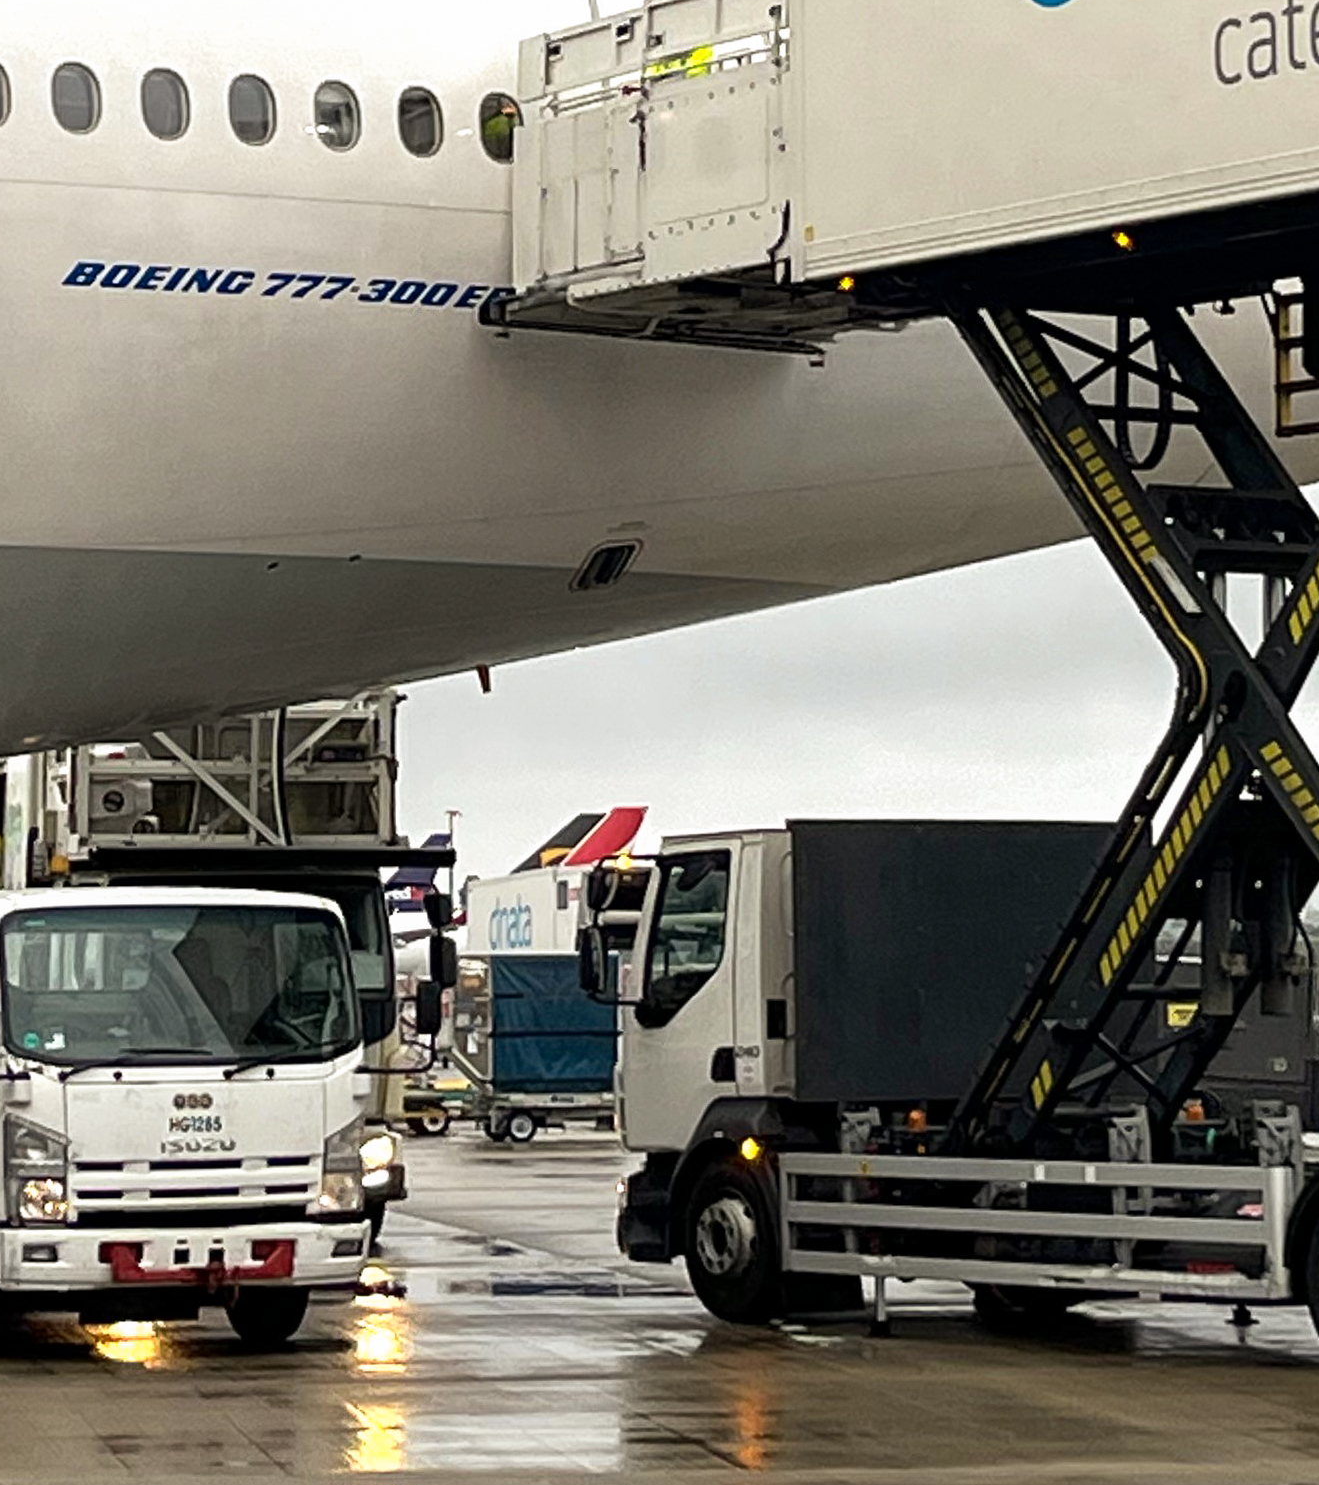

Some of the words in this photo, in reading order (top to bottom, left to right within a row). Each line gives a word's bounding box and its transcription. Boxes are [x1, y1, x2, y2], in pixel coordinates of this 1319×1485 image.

[62, 260, 255, 295] BOEING
[488, 892, 533, 951] dnata
[160, 1136, 237, 1154] ISUZU
